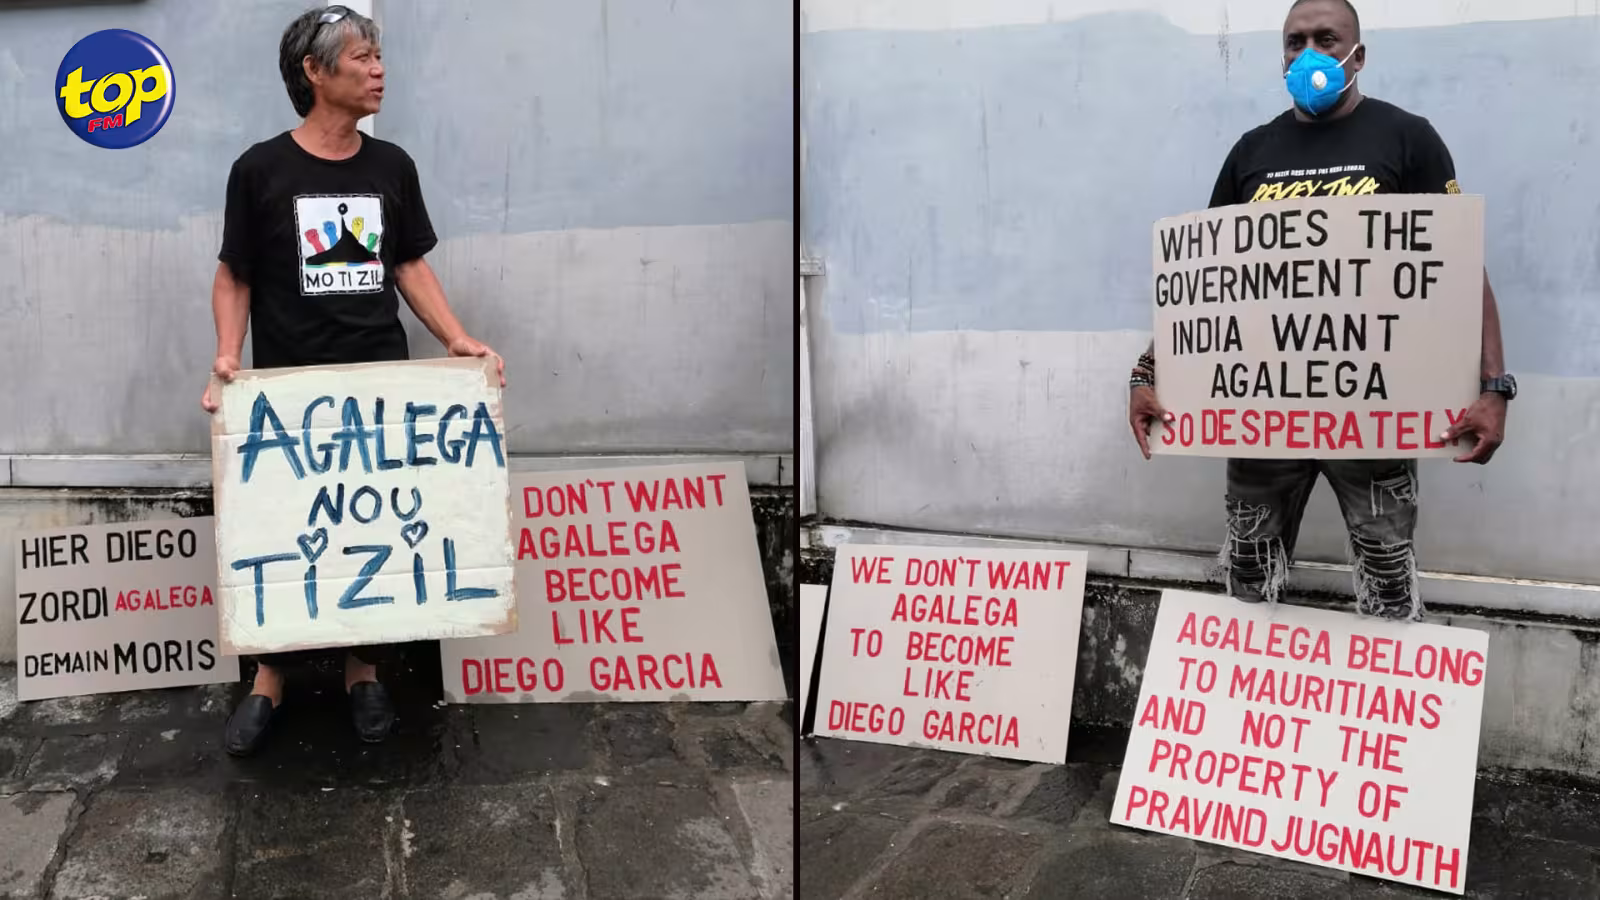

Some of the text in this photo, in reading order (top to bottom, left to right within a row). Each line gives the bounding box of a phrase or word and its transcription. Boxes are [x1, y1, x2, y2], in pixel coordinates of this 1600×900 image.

[1161, 209, 1433, 263] WHY DOES THE
[305, 269, 382, 288] MO TI ZIL
[1156, 258, 1443, 307] GOVERNMENT OF
[1172, 314, 1399, 355] INDIA WANT
[1211, 360, 1388, 400] AGALEGA
[237, 391, 505, 482] AGALEGA
[1161, 411, 1194, 447] SO
[308, 483, 422, 526] NOU
[624, 474, 726, 512] WANT
[21, 529, 196, 569] HIER DIEGO
[517, 520, 681, 560] AGALEGA
[545, 563, 686, 603] BECOME
[851, 556, 894, 584] WE
[988, 561, 1070, 590] WANT
[19, 585, 213, 624] ZORDI AGALEGA
[891, 593, 1018, 627] AGALEGA
[551, 607, 644, 644] LIKE
[25, 639, 215, 677] DEMAIN MORIS
[850, 628, 1014, 666] TO BECOME
[1176, 612, 1484, 687] AGALEGA BELONG
[462, 652, 723, 695] DIEGO GARCIA
[903, 667, 974, 701] LIKE
[1179, 657, 1443, 729] TO MAURITIANS
[828, 700, 1019, 748] DIEGO GARCIA
[1138, 695, 1408, 773] AND NOT THE
[1148, 739, 1408, 822] PROPERTY OF
[1125, 785, 1460, 888] PRAVIND JUGNAUTH
